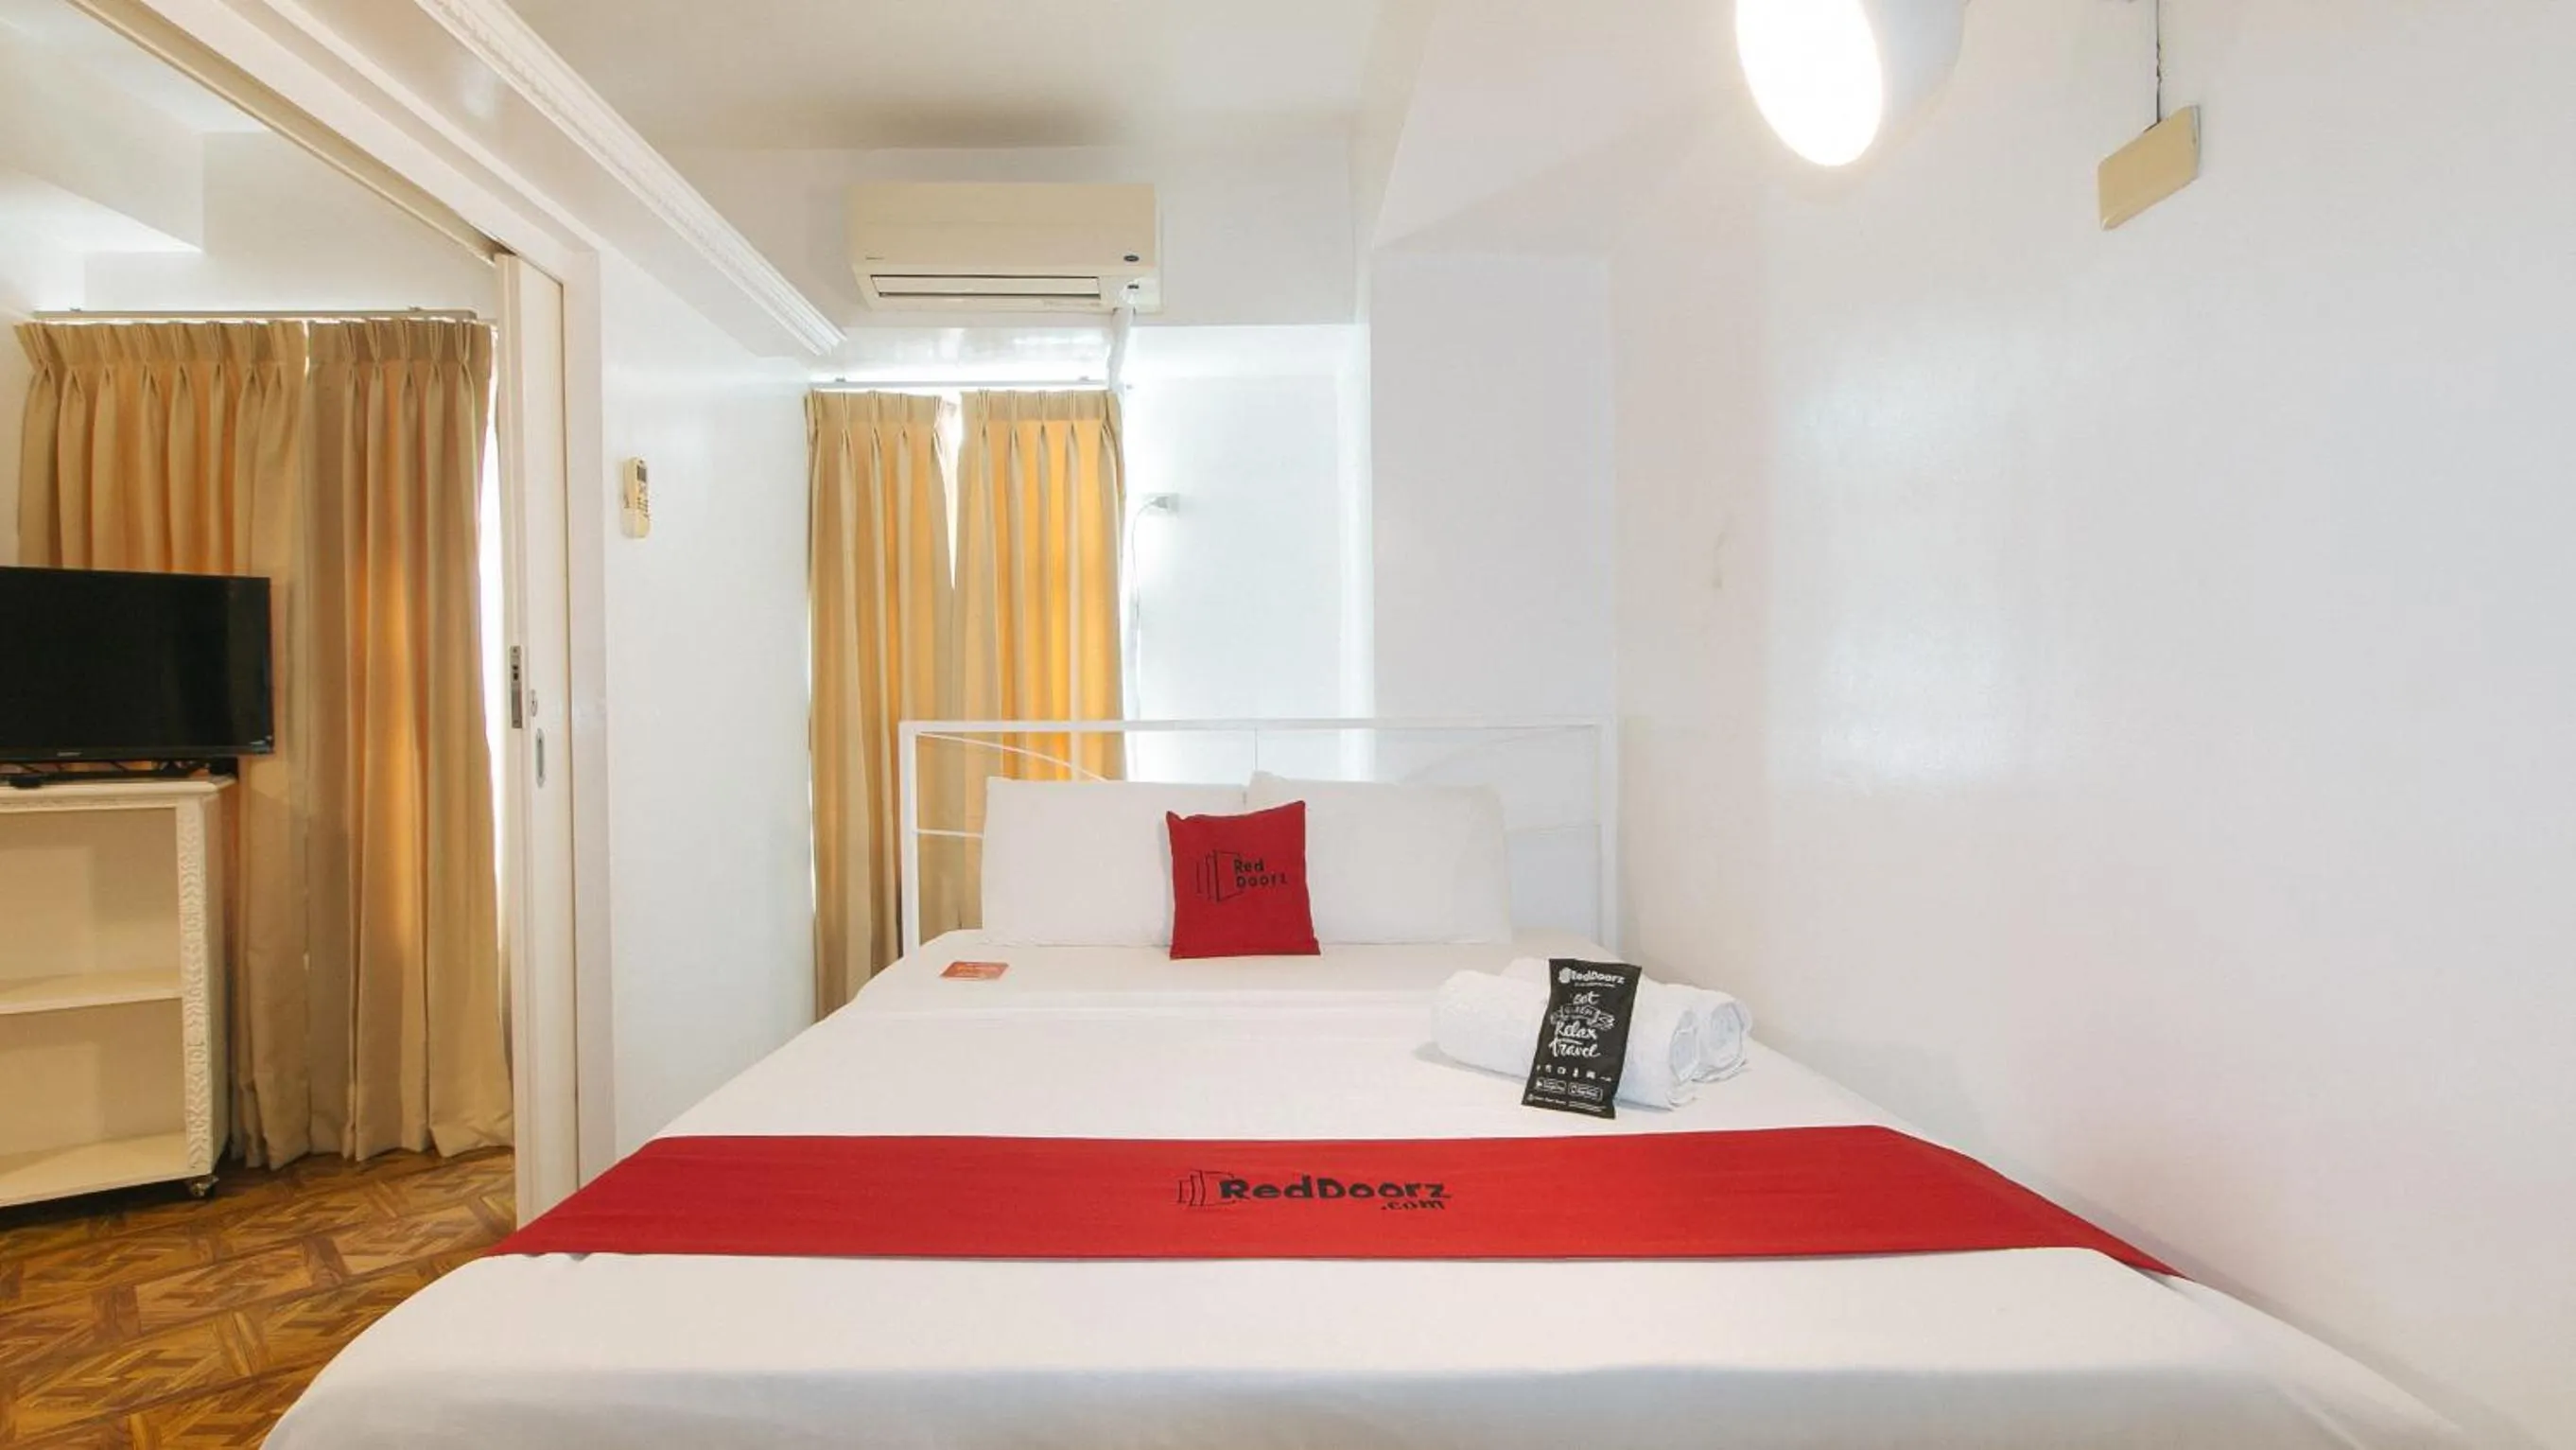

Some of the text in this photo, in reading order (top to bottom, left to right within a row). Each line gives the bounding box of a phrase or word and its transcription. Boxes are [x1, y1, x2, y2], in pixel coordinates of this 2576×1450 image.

[1234, 858, 1264, 873] Red
[1219, 1175, 1452, 1199] RedDoorz
[1380, 1198, 1445, 1211] .com
